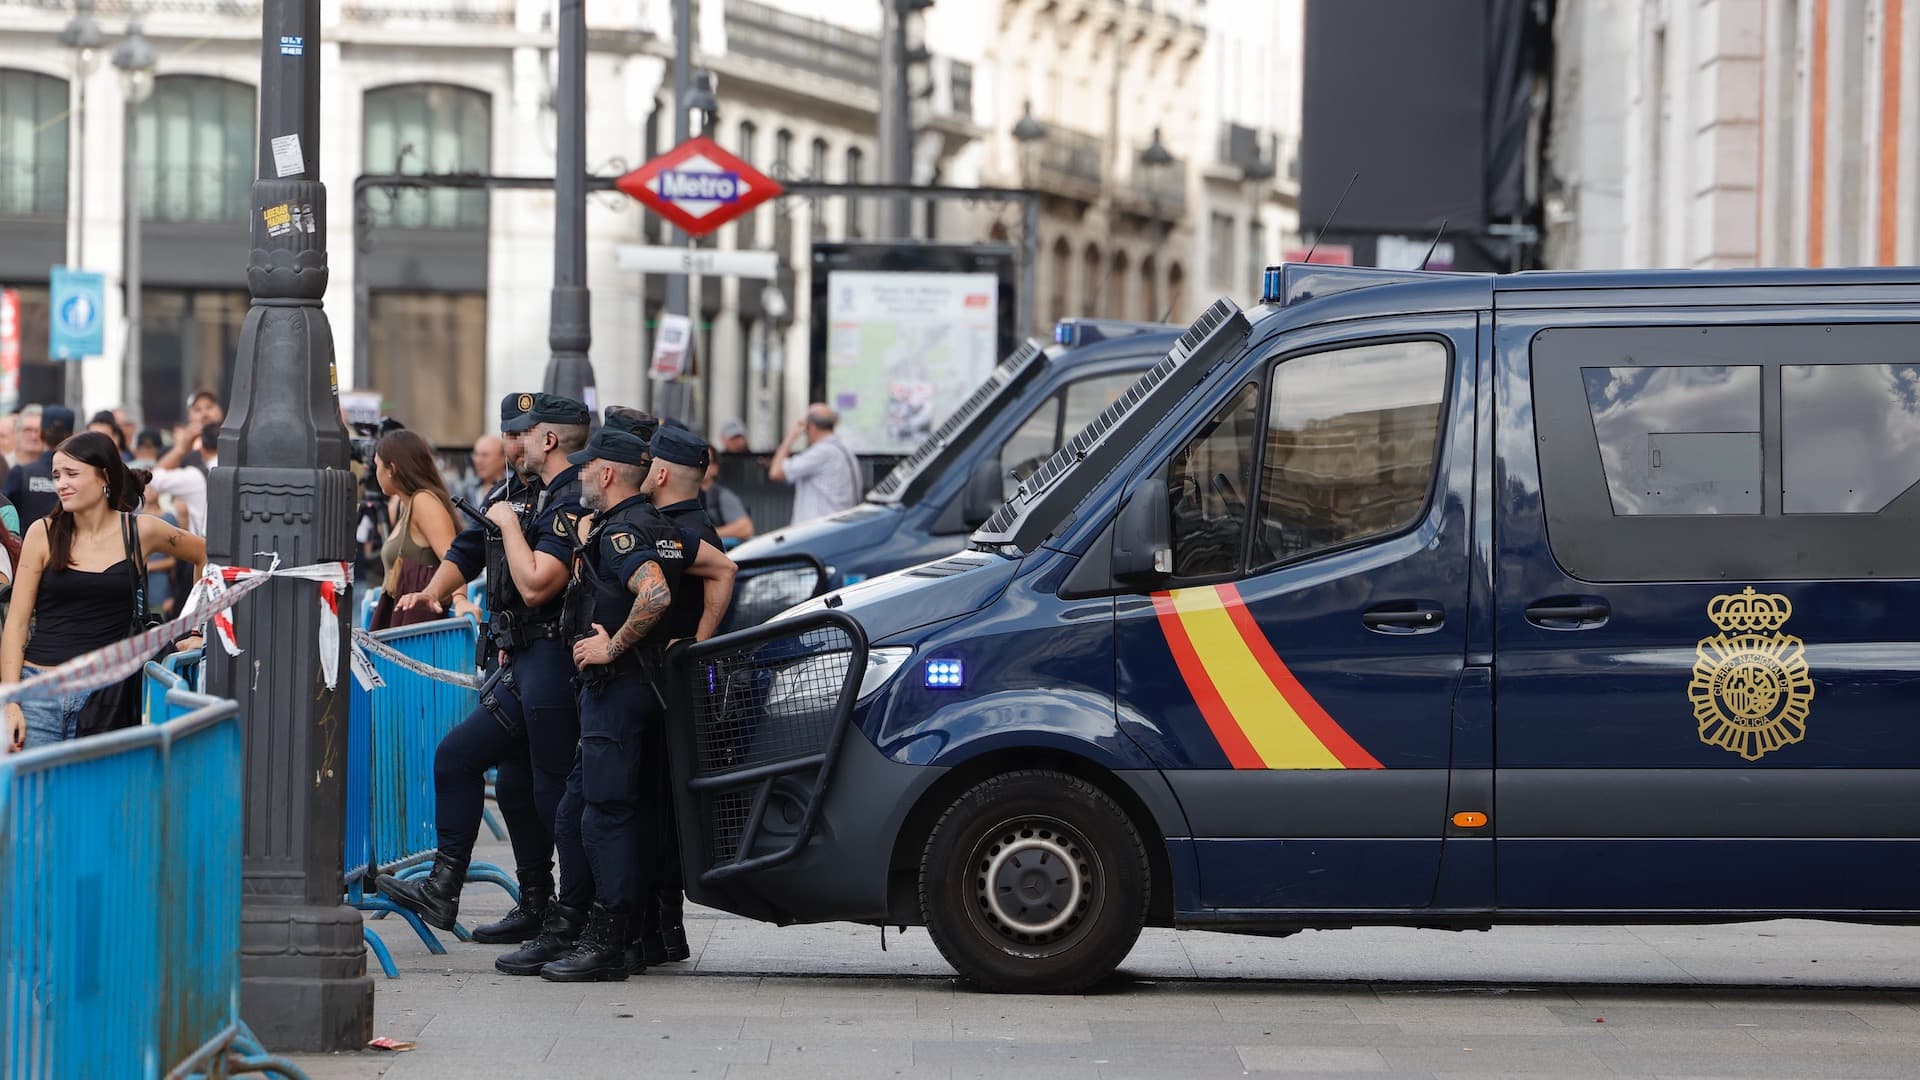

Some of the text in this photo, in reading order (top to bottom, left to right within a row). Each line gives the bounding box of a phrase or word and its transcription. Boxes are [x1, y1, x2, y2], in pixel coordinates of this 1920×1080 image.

[661, 171, 735, 198] Metro
[1714, 654, 1789, 697] CUERPO NACIONAL DE
[1733, 715, 1771, 727] POLICIA
